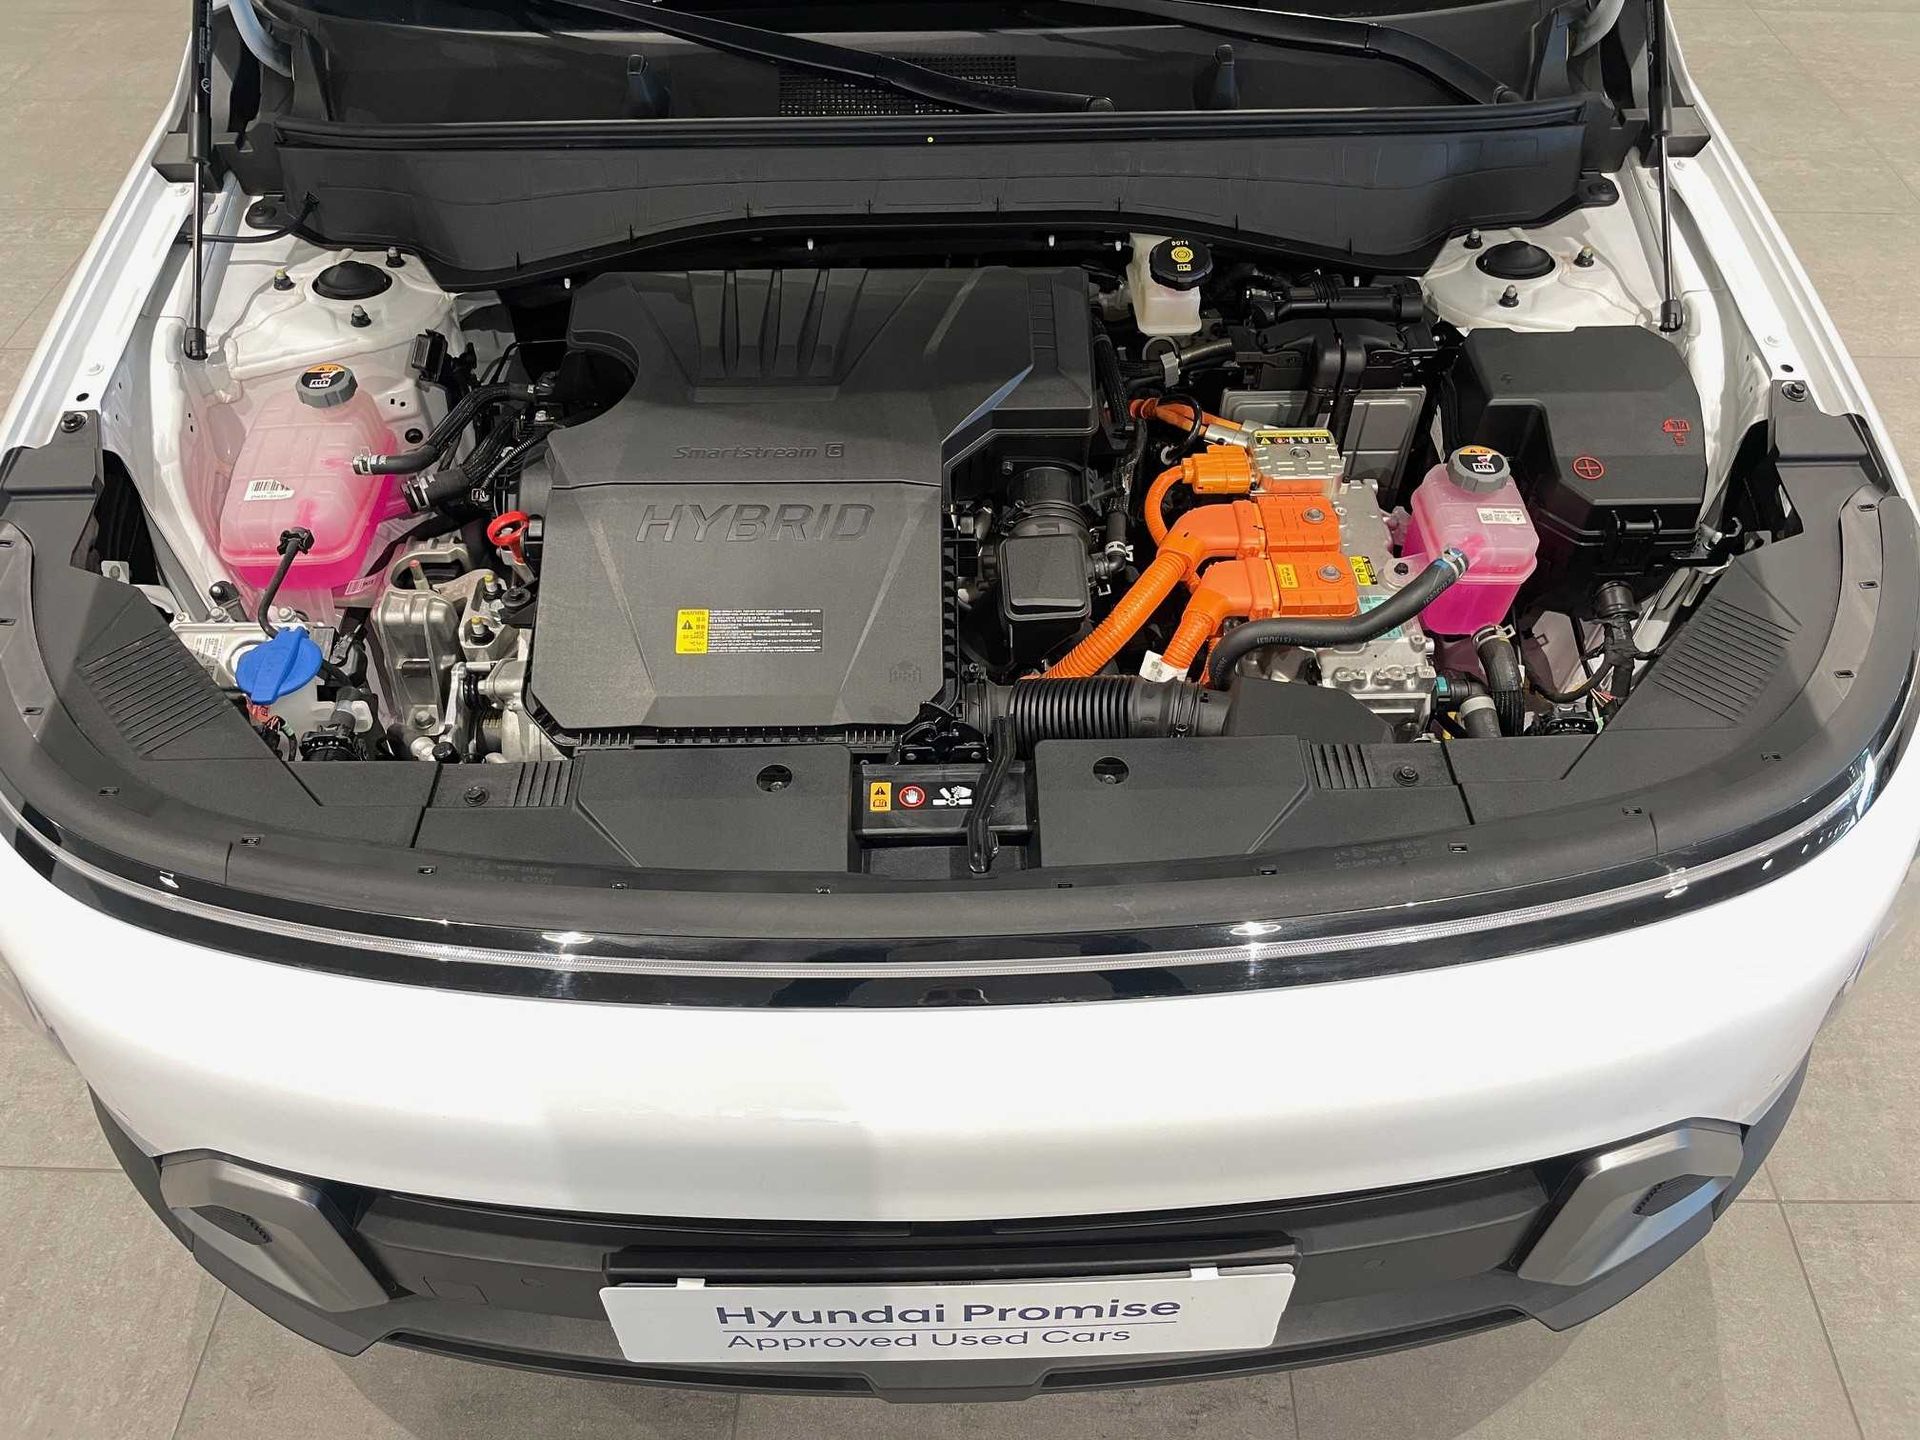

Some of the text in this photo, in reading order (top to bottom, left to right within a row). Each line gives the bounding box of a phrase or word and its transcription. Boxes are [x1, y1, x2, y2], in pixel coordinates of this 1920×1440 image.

[672, 445, 818, 459] Smartstream
[635, 503, 876, 543] HYBRID
[716, 1299, 1182, 1328] Hyundai Promise
[728, 1330, 1131, 1350] Approved Used Cars
